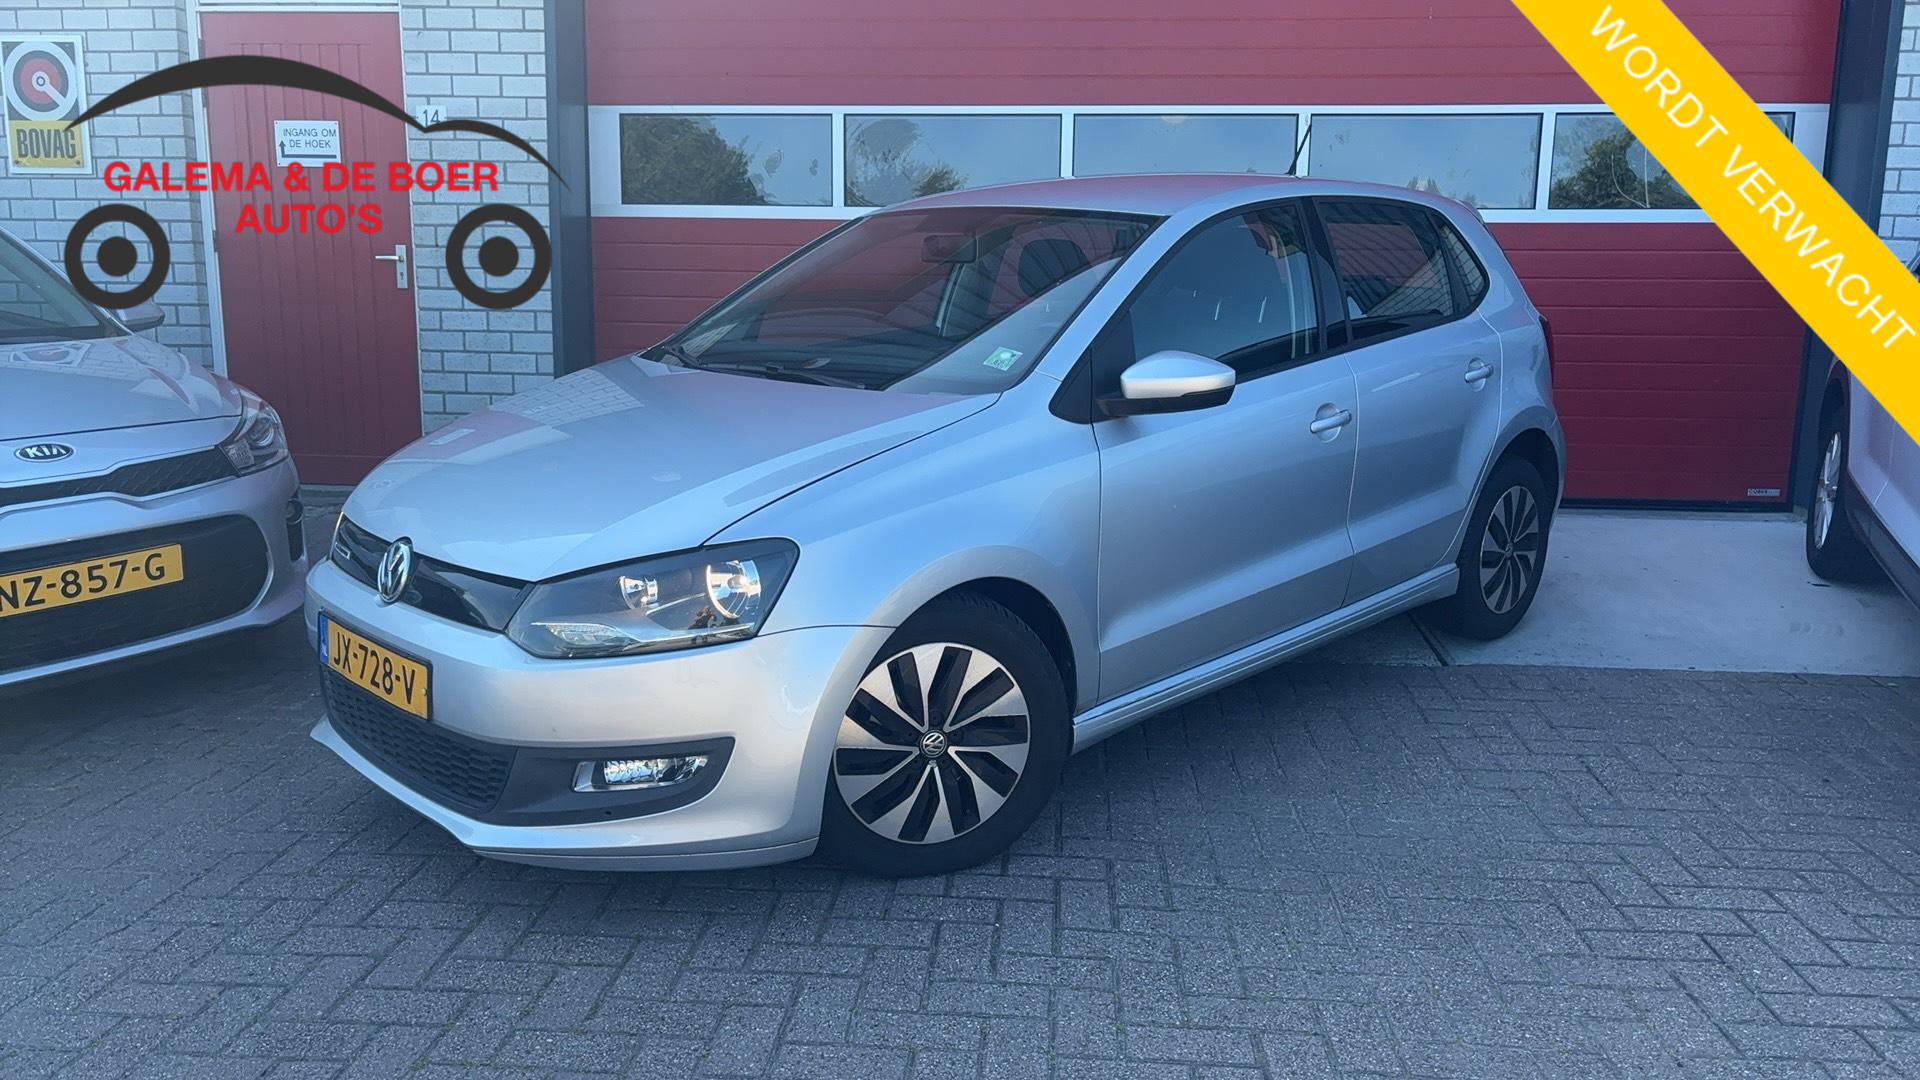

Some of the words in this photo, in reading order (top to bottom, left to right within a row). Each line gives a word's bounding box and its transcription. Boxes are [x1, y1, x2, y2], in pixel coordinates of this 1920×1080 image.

[422, 109, 441, 127] 14
[283, 128, 318, 138] INGANG
[321, 128, 337, 138] OM
[16, 128, 76, 159] BOVAG
[289, 139, 302, 148] DE
[305, 139, 331, 148] HOEK
[25, 444, 67, 459] KIA
[0, 553, 165, 612] NZ-857-G
[333, 631, 416, 706] JX-728-V
